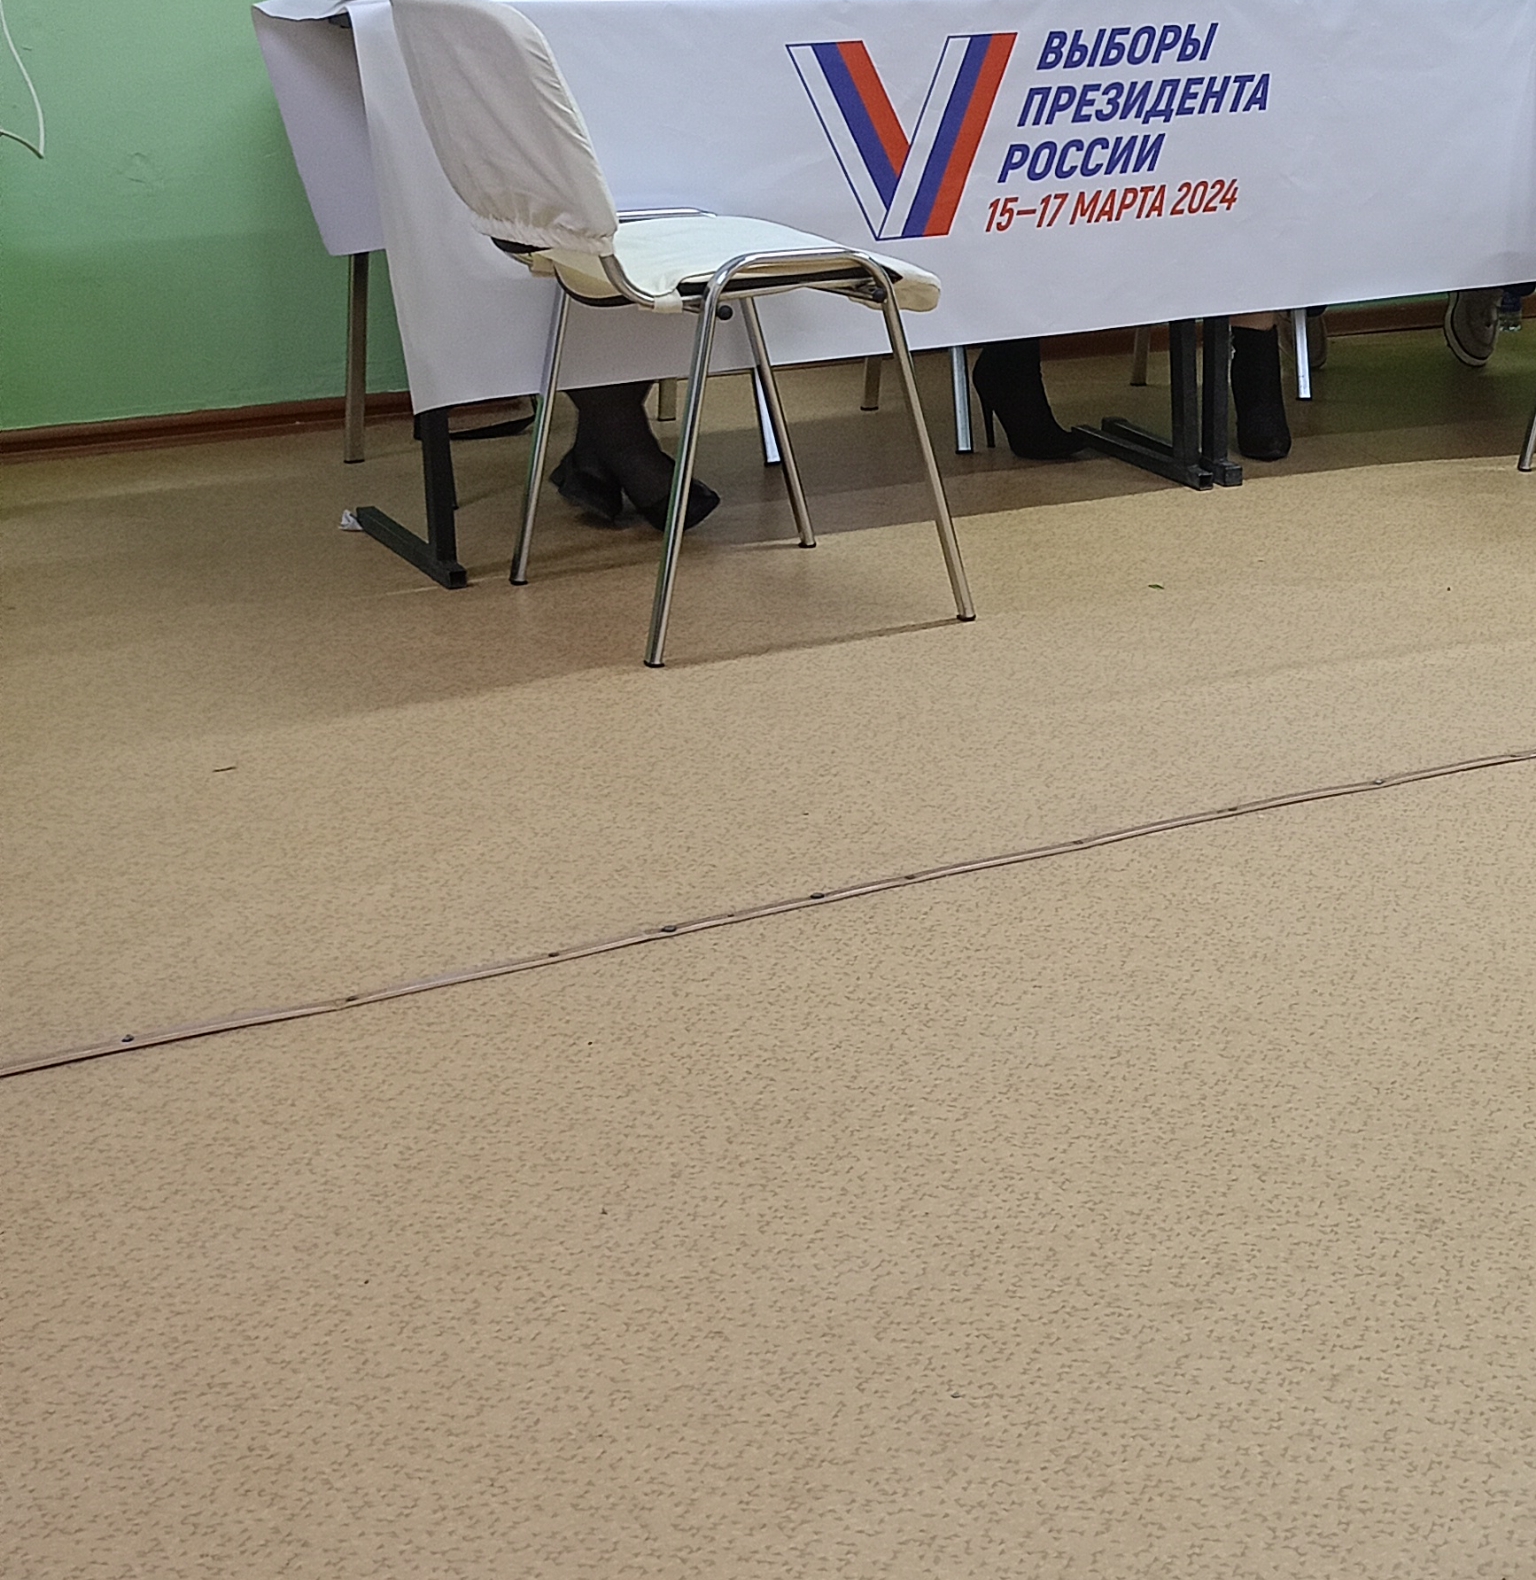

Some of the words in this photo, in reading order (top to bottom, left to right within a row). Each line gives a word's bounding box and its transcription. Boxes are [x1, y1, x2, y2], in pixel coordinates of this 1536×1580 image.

[1036, 22, 1219, 70] ВЫБОРЫ
[1017, 73, 1270, 127] ПРЕЗИДЕНТА
[997, 133, 1166, 183] РОССИИ
[1069, 184, 1167, 225] МАРТА
[1169, 178, 1239, 216] 2024
